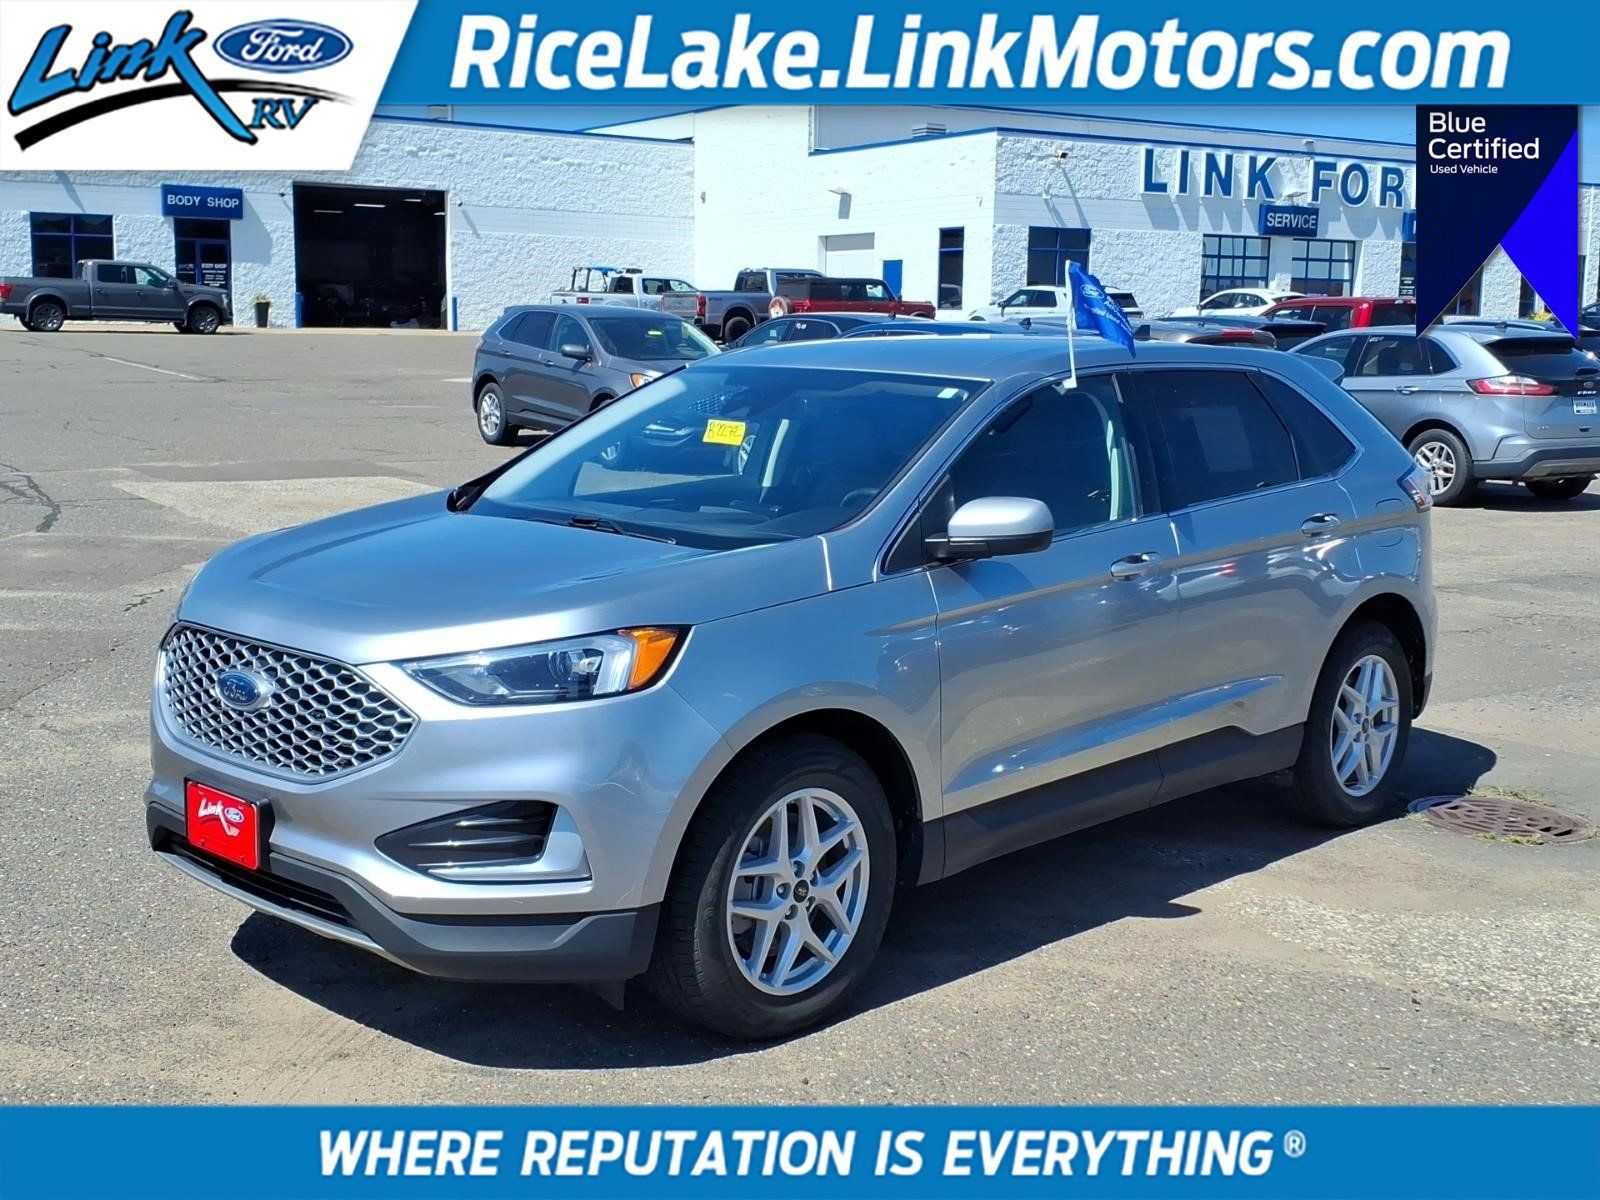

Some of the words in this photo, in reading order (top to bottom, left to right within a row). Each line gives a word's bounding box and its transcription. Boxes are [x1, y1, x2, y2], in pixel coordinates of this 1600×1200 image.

[1141, 147, 1278, 200] LINK
[1310, 160, 1416, 209] FOR
[167, 194, 201, 206] BODY
[207, 197, 239, 208] SHOP
[1266, 212, 1317, 229] SERVICE
[198, 798, 231, 836] Link
